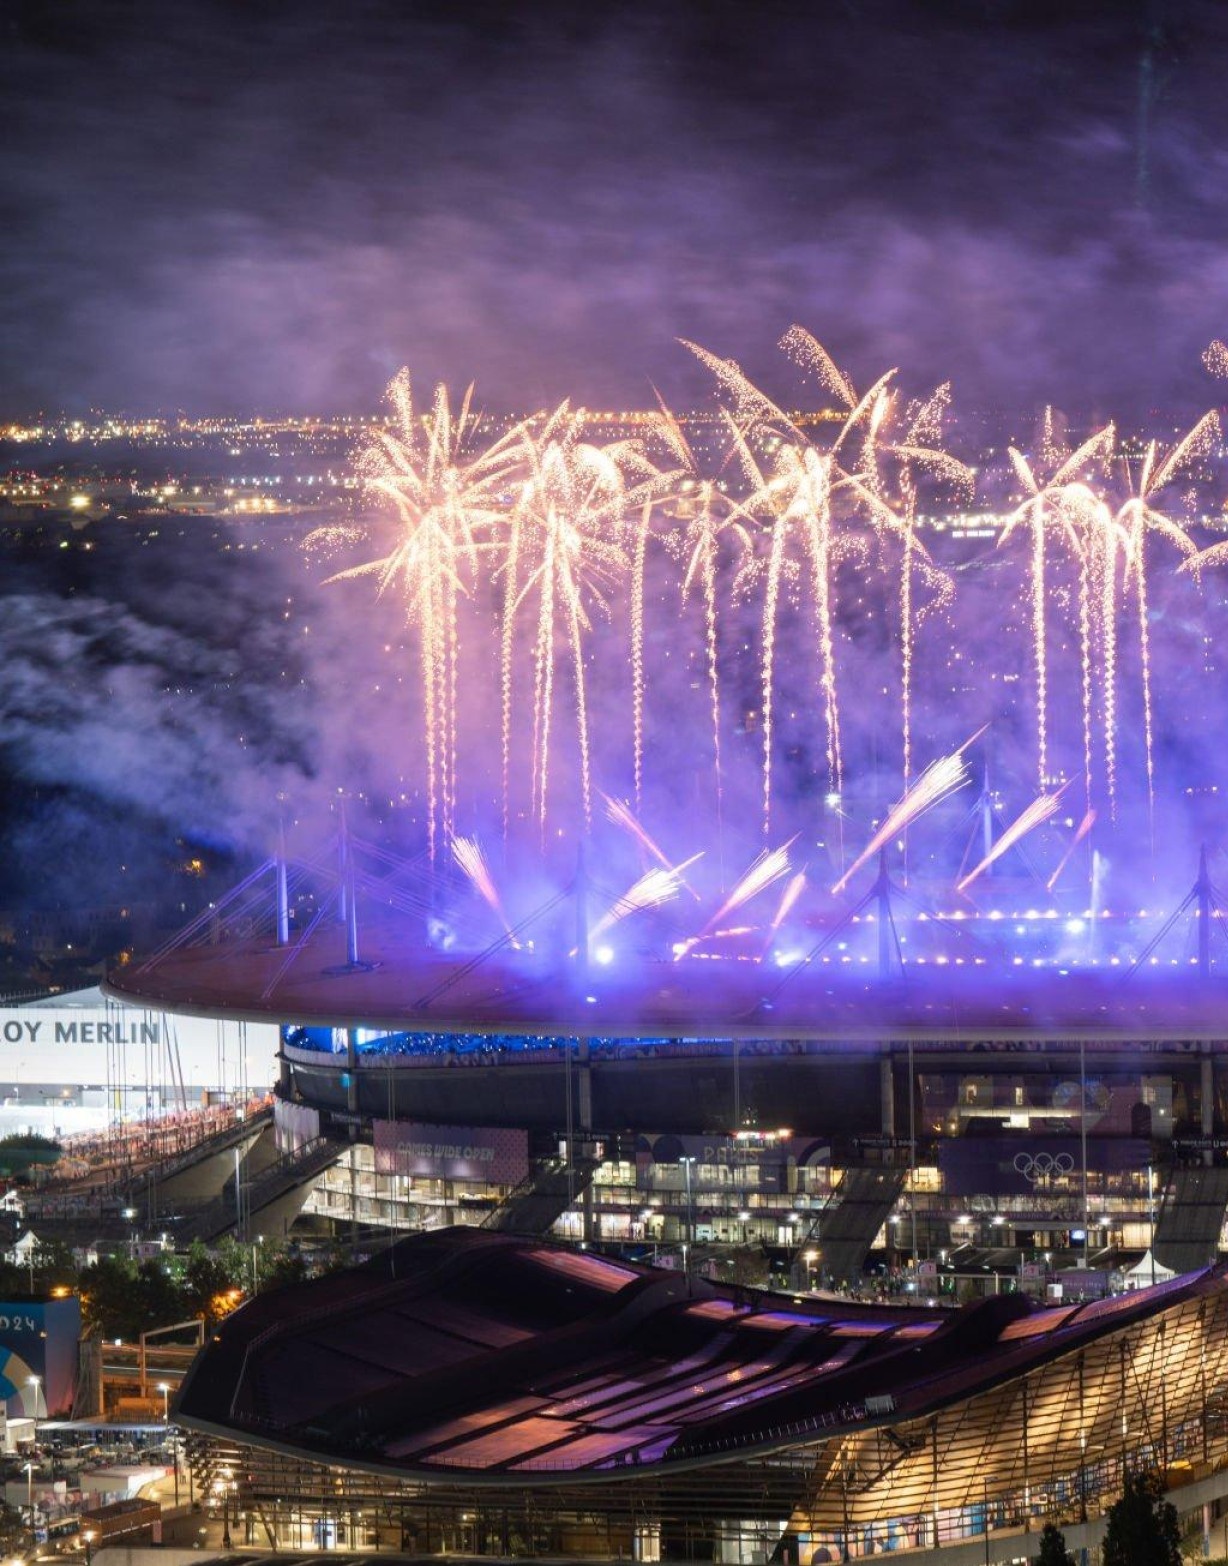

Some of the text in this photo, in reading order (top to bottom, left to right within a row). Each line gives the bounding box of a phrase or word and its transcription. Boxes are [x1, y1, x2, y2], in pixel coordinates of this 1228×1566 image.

[0, 1021, 160, 1044] OY MERLIN
[434, 1144, 461, 1159] WIDE
[463, 1146, 496, 1161] OPEN
[704, 1146, 759, 1164] PARIS
